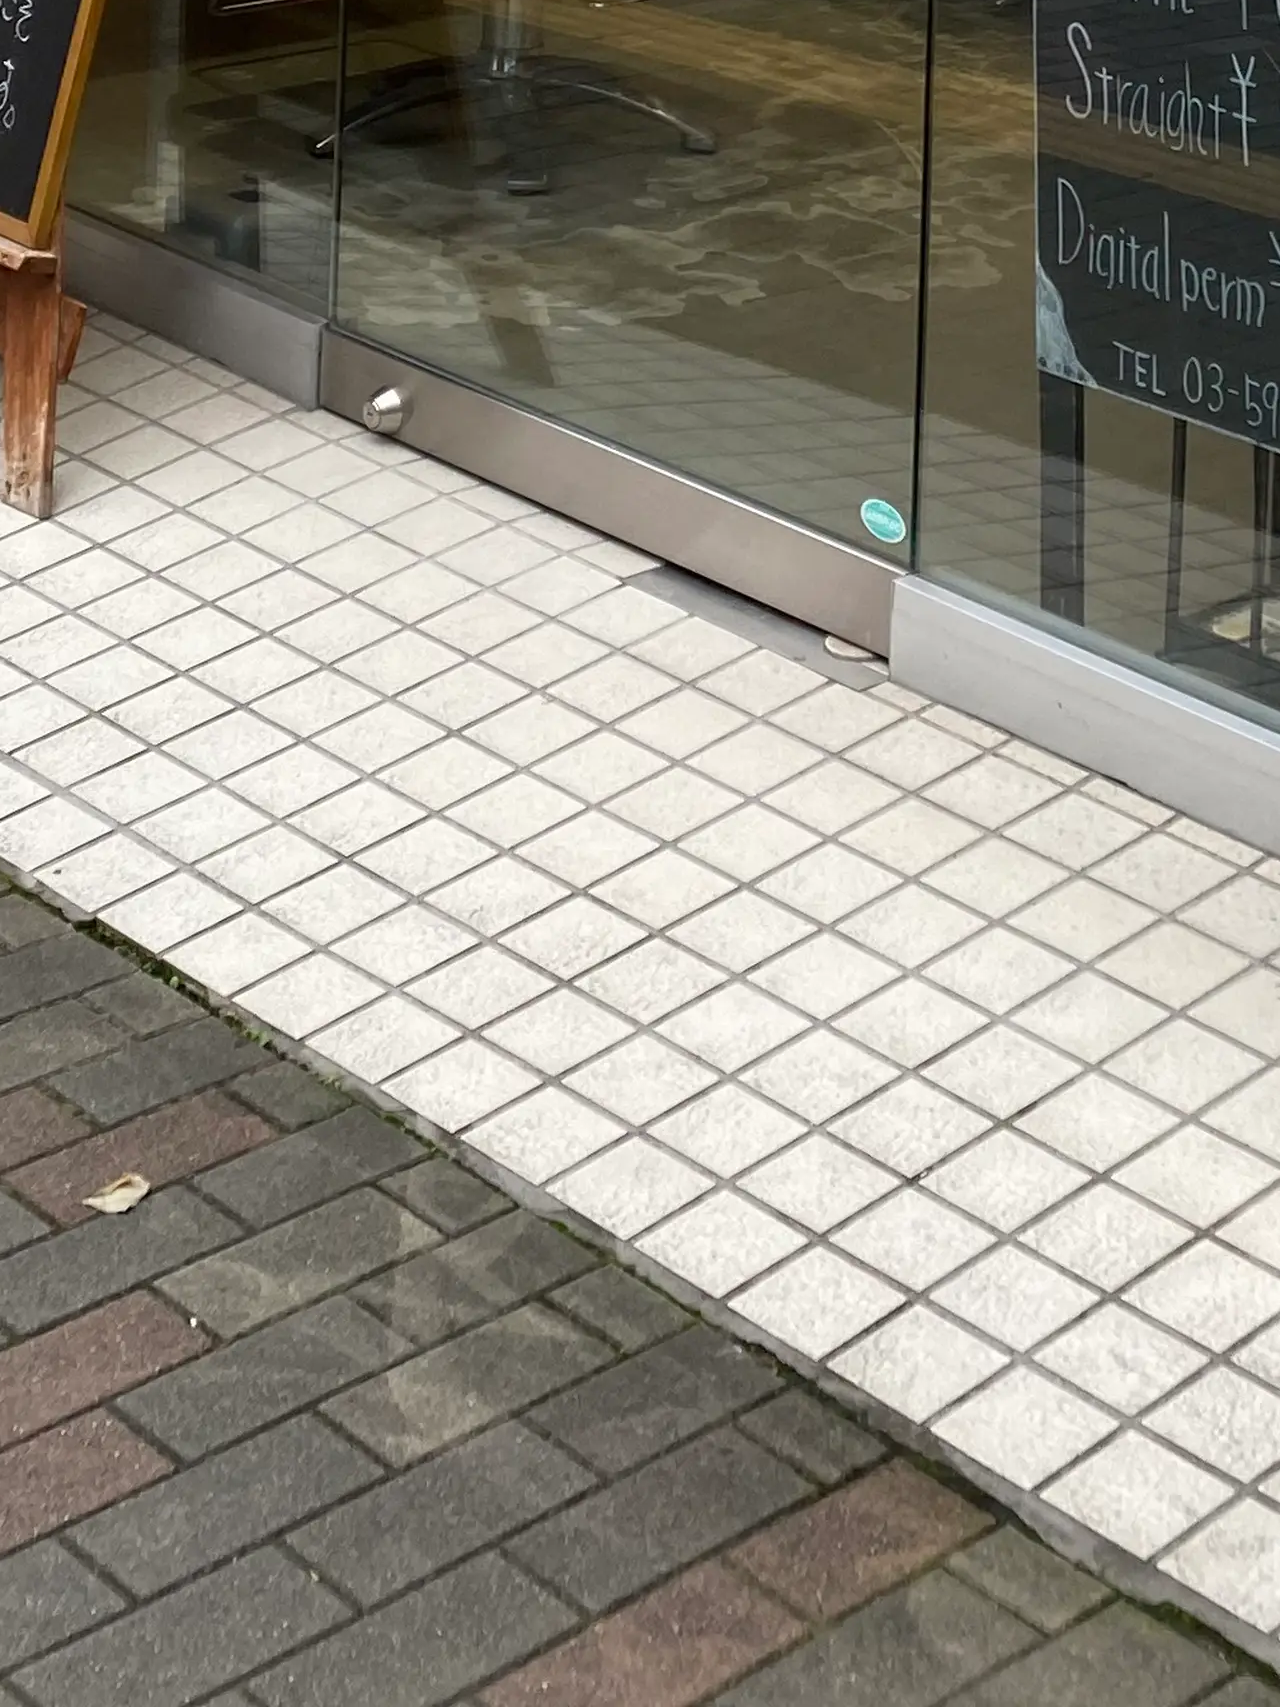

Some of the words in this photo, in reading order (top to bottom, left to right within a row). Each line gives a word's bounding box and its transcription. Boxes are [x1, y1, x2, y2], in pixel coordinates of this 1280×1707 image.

[1065, 21, 1228, 160] Straight
[1057, 176, 1171, 302] Digital
[1180, 258, 1266, 328] perm
[1112, 341, 1167, 396] TEL
